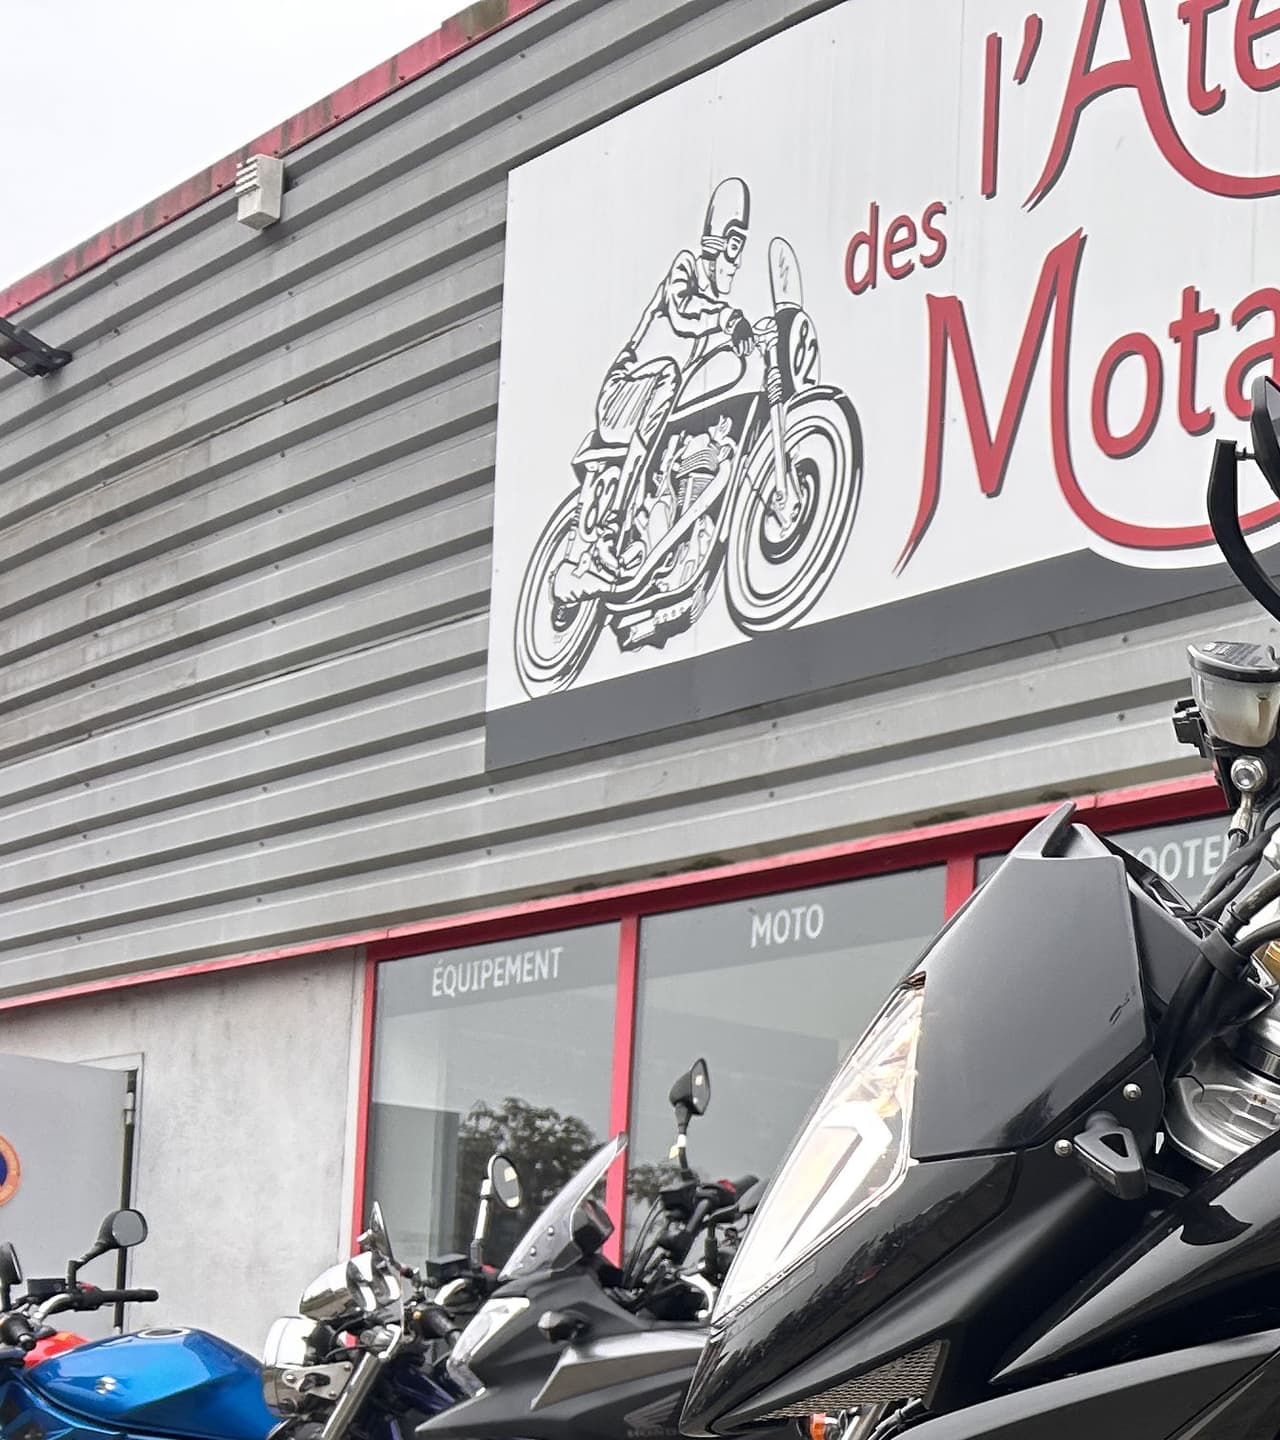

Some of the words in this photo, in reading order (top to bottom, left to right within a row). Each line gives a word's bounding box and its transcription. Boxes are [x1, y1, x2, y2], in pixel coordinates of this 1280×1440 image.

[844, 199, 949, 297] des
[750, 903, 824, 949] MOTO
[431, 945, 565, 999] ÉQUIPEMENT
